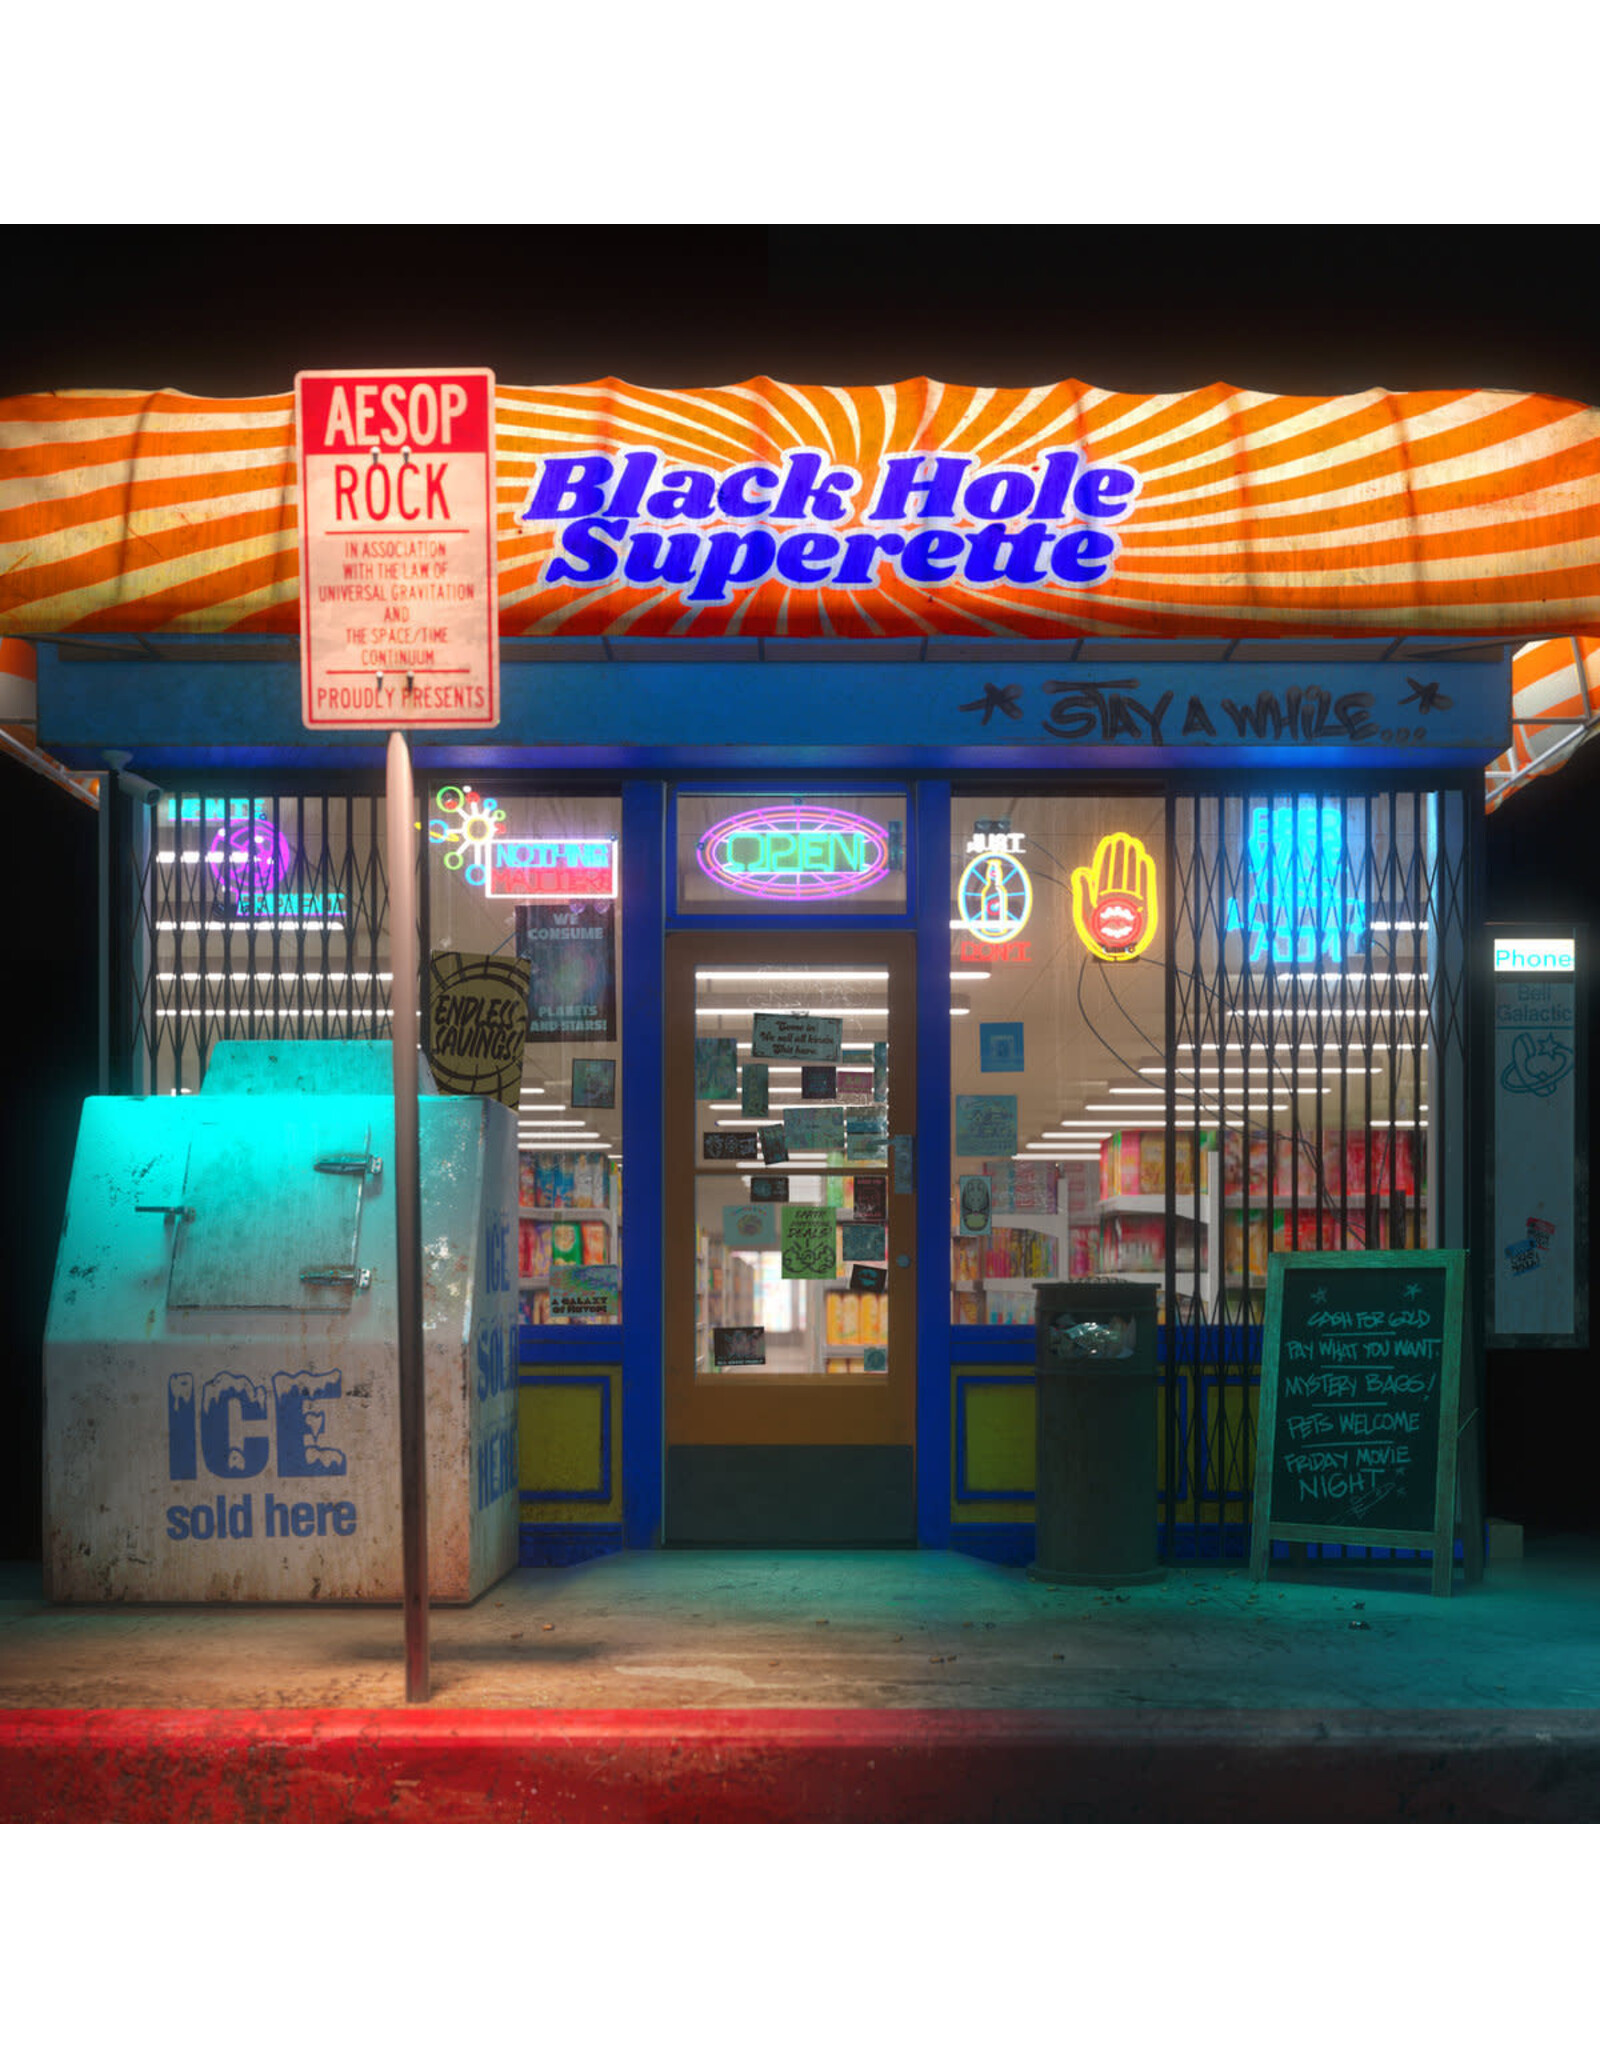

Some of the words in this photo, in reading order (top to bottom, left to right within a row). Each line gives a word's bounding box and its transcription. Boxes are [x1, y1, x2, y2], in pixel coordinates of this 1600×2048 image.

[324, 383, 468, 446] AESOP
[335, 462, 451, 522] ROCK
[521, 450, 859, 522] Black
[867, 450, 1137, 522] Hole
[345, 541, 358, 558] IN
[362, 541, 447, 558] ASSOCIATION
[543, 517, 1117, 602] Superette
[343, 563, 373, 580] WITH
[378, 562, 399, 579] THE
[403, 562, 429, 579] LAW
[434, 562, 448, 578] OF
[318, 585, 387, 602] UNIVERSAL
[391, 584, 475, 600] GRAVITATION
[384, 606, 410, 622] AND
[346, 628, 366, 644] THE
[371, 627, 448, 644] SPACE/TIME
[362, 650, 435, 666] CONTINUUM
[317, 687, 395, 709] PROUDLY
[402, 686, 485, 709] PRESENTS
[1043, 679, 1174, 745] STAY
[1183, 696, 1216, 738] A
[724, 832, 867, 873] OPEN
[966, 833, 1026, 853] JUST
[553, 913, 579, 926] WE
[527, 927, 604, 940] CONSUME
[1496, 949, 1571, 968] Phone
[1518, 982, 1551, 1001] Bell
[538, 1005, 598, 1017] PLANETS
[1497, 1004, 1572, 1023] Galactic
[530, 1020, 558, 1032] AND
[561, 1019, 607, 1032] STARS!
[486, 1210, 511, 1294] ICE
[1307, 1311, 1352, 1327] CASH
[1356, 1311, 1385, 1328] FOR
[1388, 1309, 1431, 1327] GOLD
[1286, 1340, 1314, 1360] PAY
[1319, 1339, 1357, 1361] WHAT
[1363, 1341, 1390, 1360] YOU
[1285, 1373, 1357, 1397] MYSTERY
[1366, 1373, 1436, 1400] BAGS!
[168, 1367, 347, 1481] ICE
[1287, 1413, 1334, 1439] PETS
[1339, 1411, 1420, 1435] WELCOME
[1284, 1451, 1350, 1474] FRIDAY
[1356, 1446, 1412, 1467] MOVIE
[1299, 1468, 1386, 1500] NIGHT
[166, 1493, 253, 1541] sold
[265, 1493, 357, 1538] here
